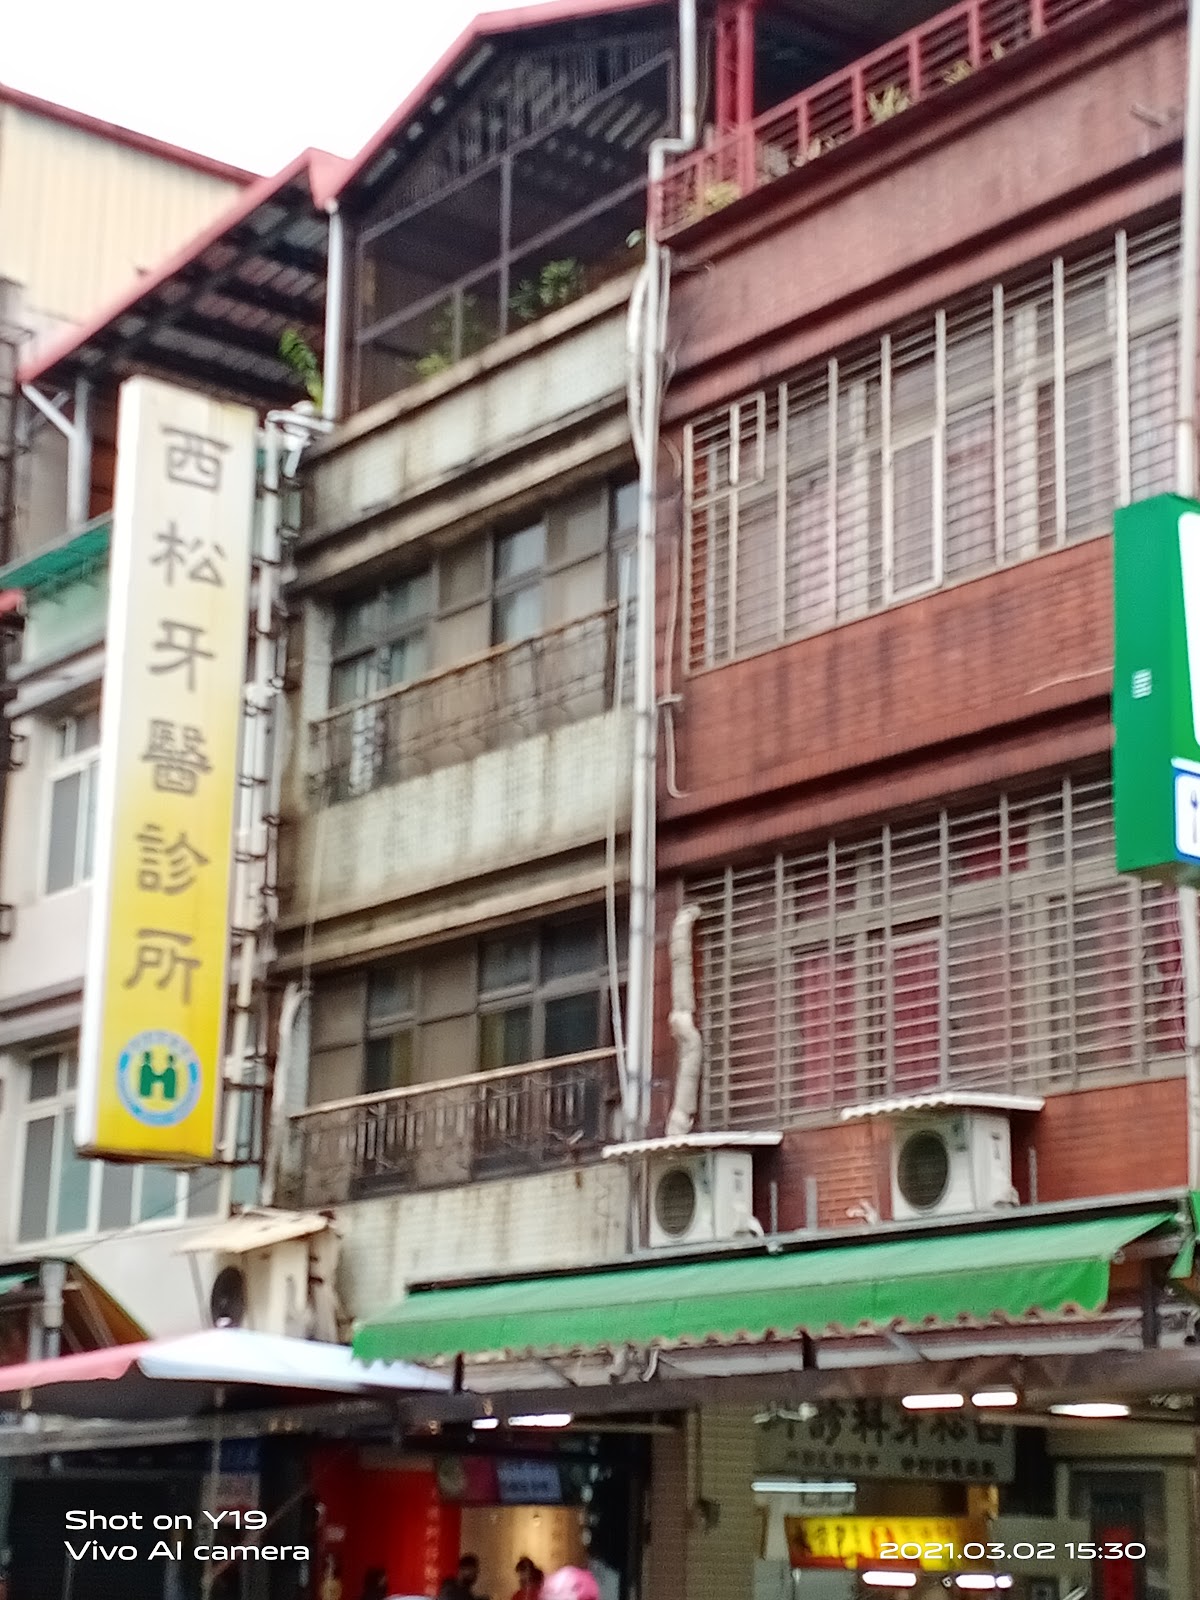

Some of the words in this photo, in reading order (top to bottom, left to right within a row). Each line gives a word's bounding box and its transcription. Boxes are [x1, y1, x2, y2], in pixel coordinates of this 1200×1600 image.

[122, 424, 231, 1005] 西松牙醫診所
